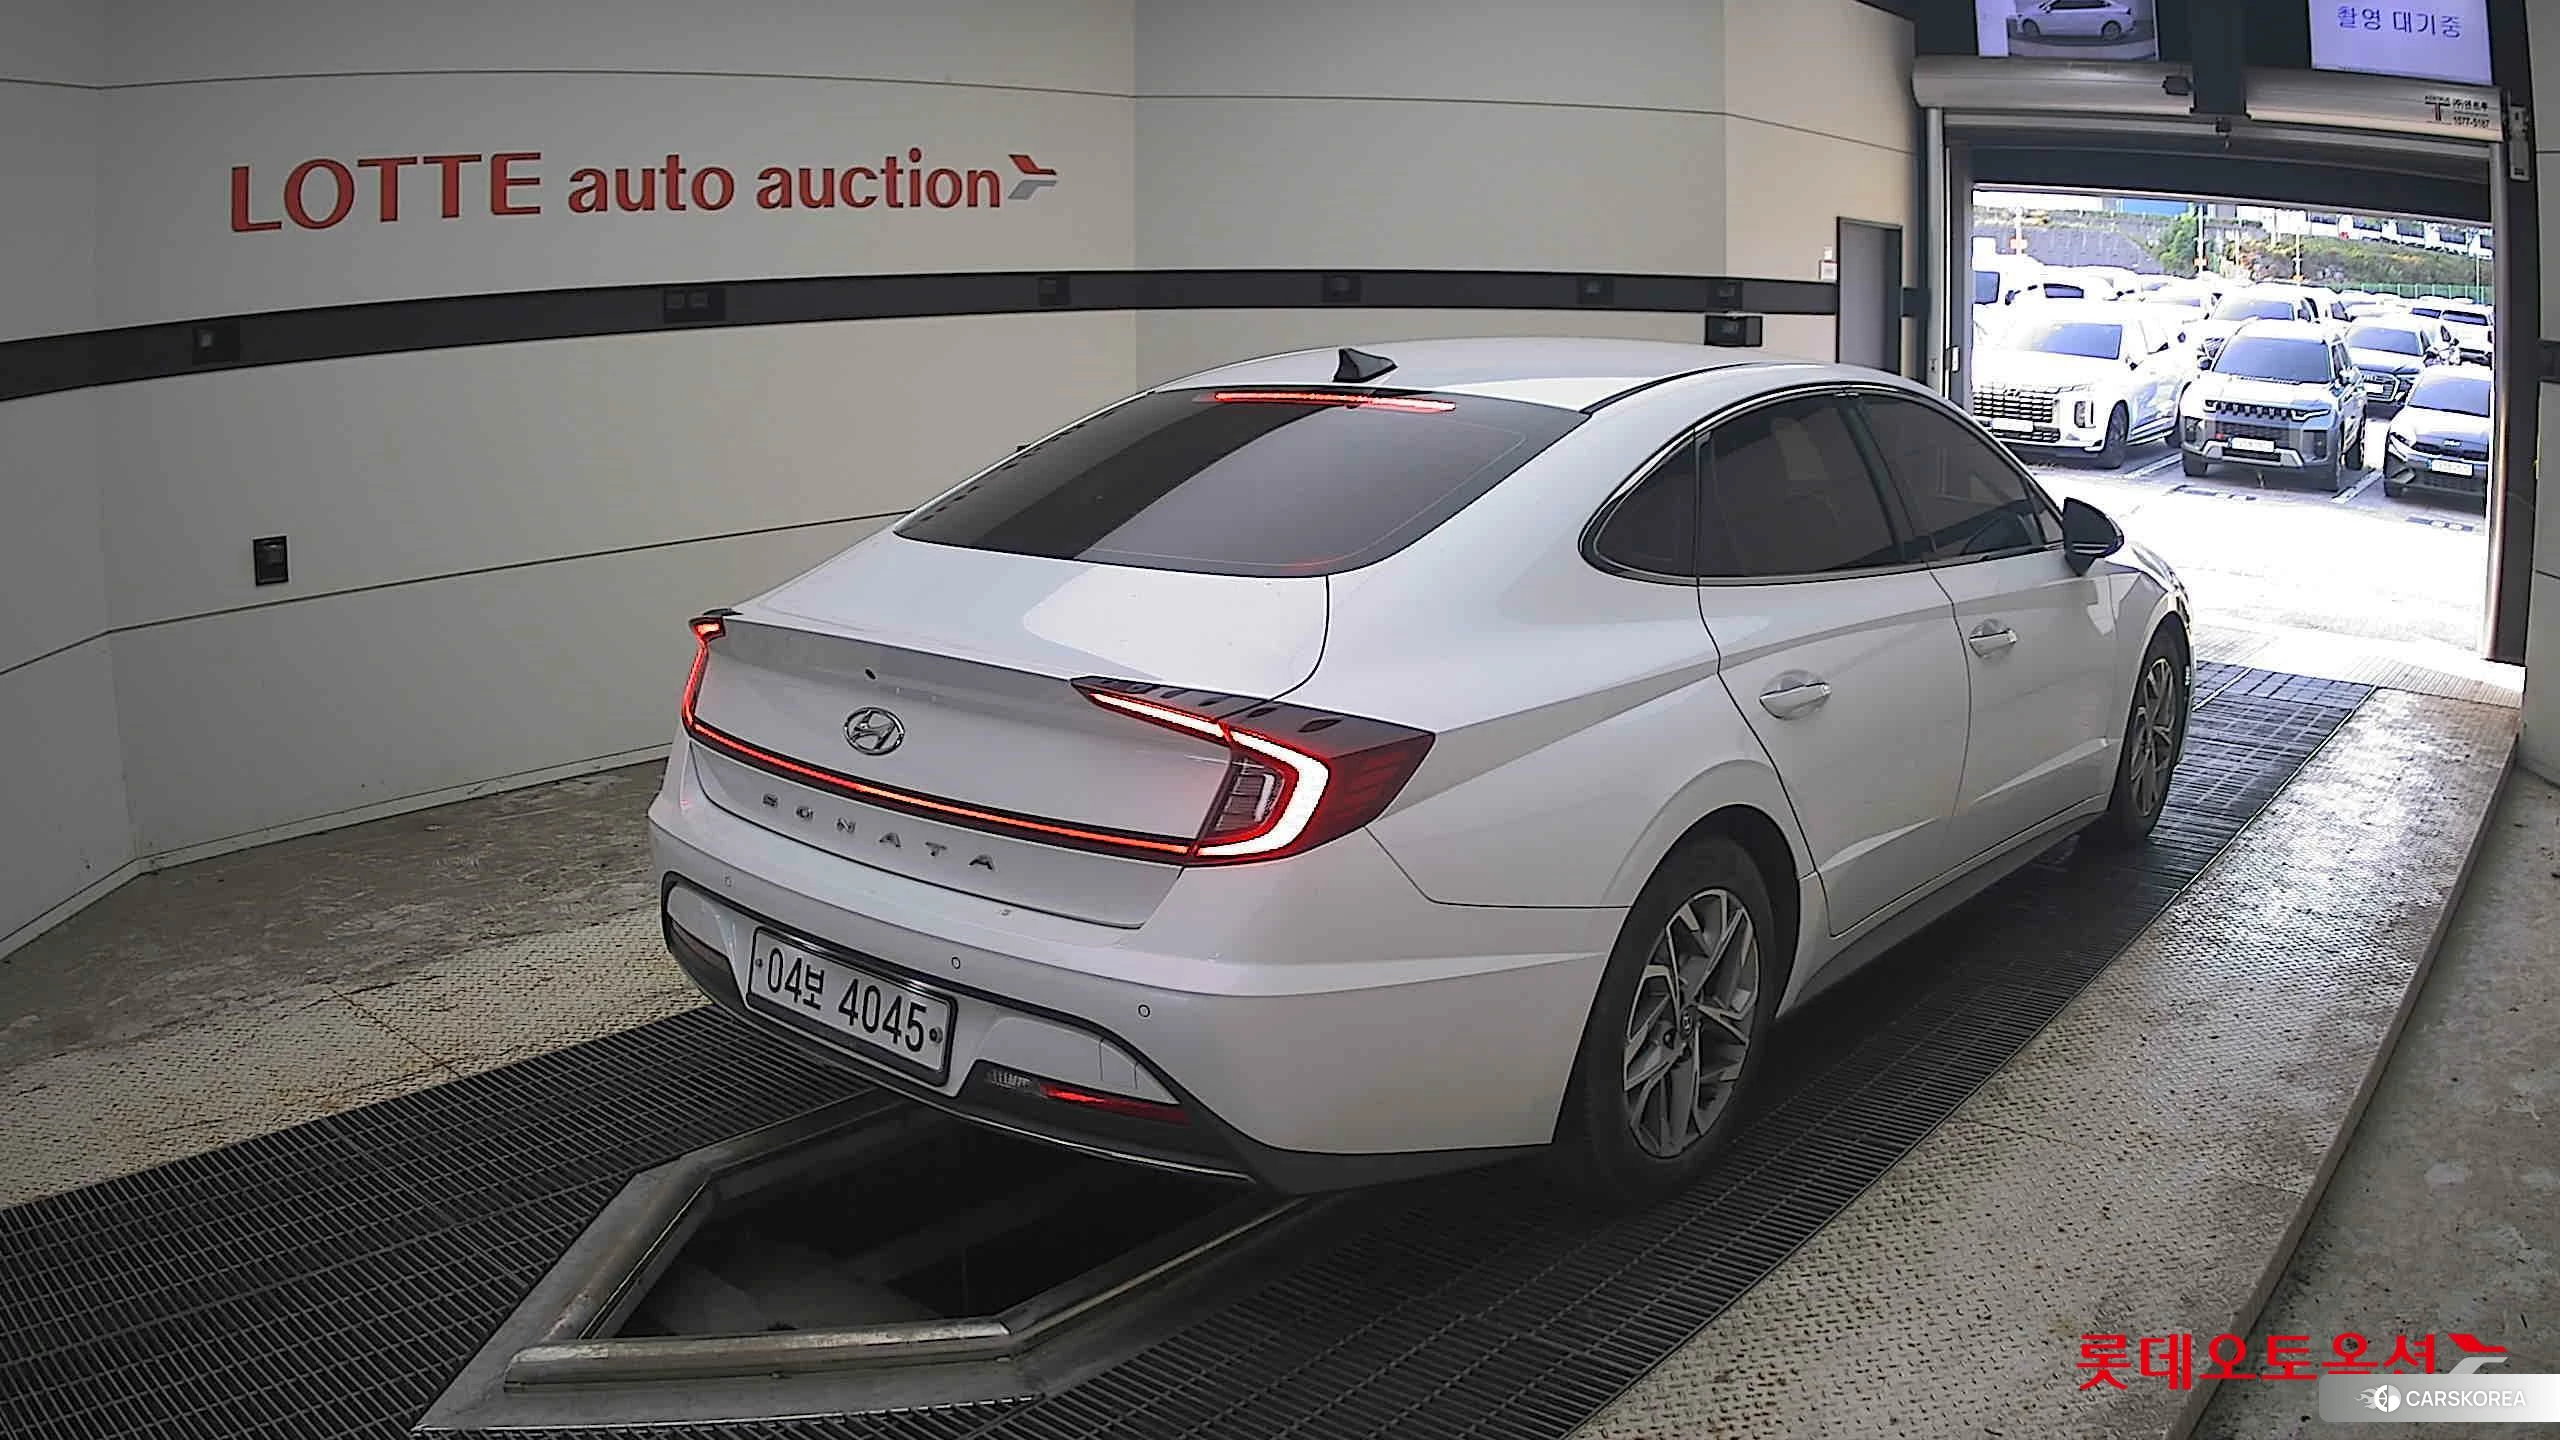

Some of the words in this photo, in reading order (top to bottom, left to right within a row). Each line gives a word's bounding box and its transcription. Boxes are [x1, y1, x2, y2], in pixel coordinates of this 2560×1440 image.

[2337, 5, 2382, 31] 촬영
[2392, 11, 2462, 39] 대기중
[231, 152, 542, 232] LOTTE
[567, 154, 735, 213] auto
[757, 147, 1001, 210] auction
[762, 793, 994, 871] SONATA
[767, 947, 825, 1011] 04보
[837, 978, 928, 1052] 4045
